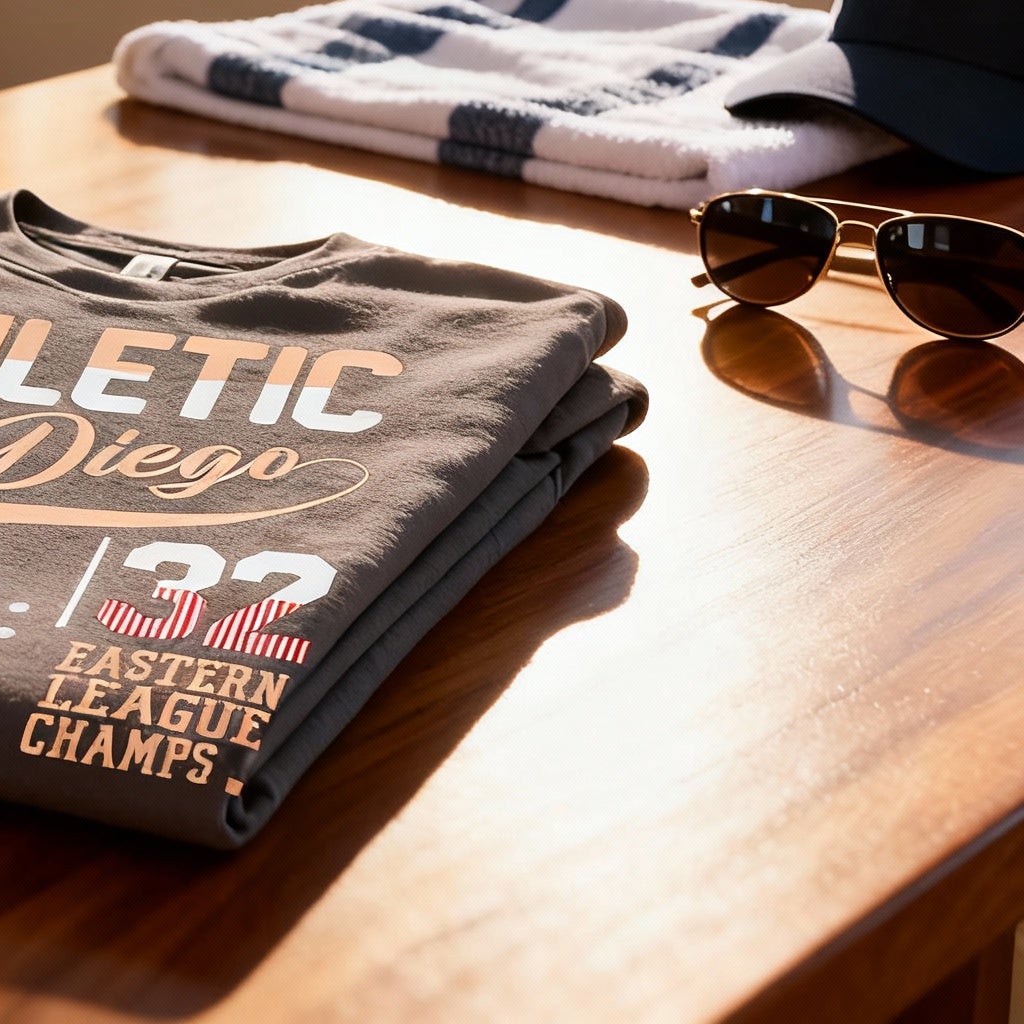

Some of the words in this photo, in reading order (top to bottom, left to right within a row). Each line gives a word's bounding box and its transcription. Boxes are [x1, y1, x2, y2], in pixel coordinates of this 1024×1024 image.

[97, 541, 338, 664] 32
[37, 674, 272, 751] LEAGUE
[54, 640, 290, 711] EASTERN
